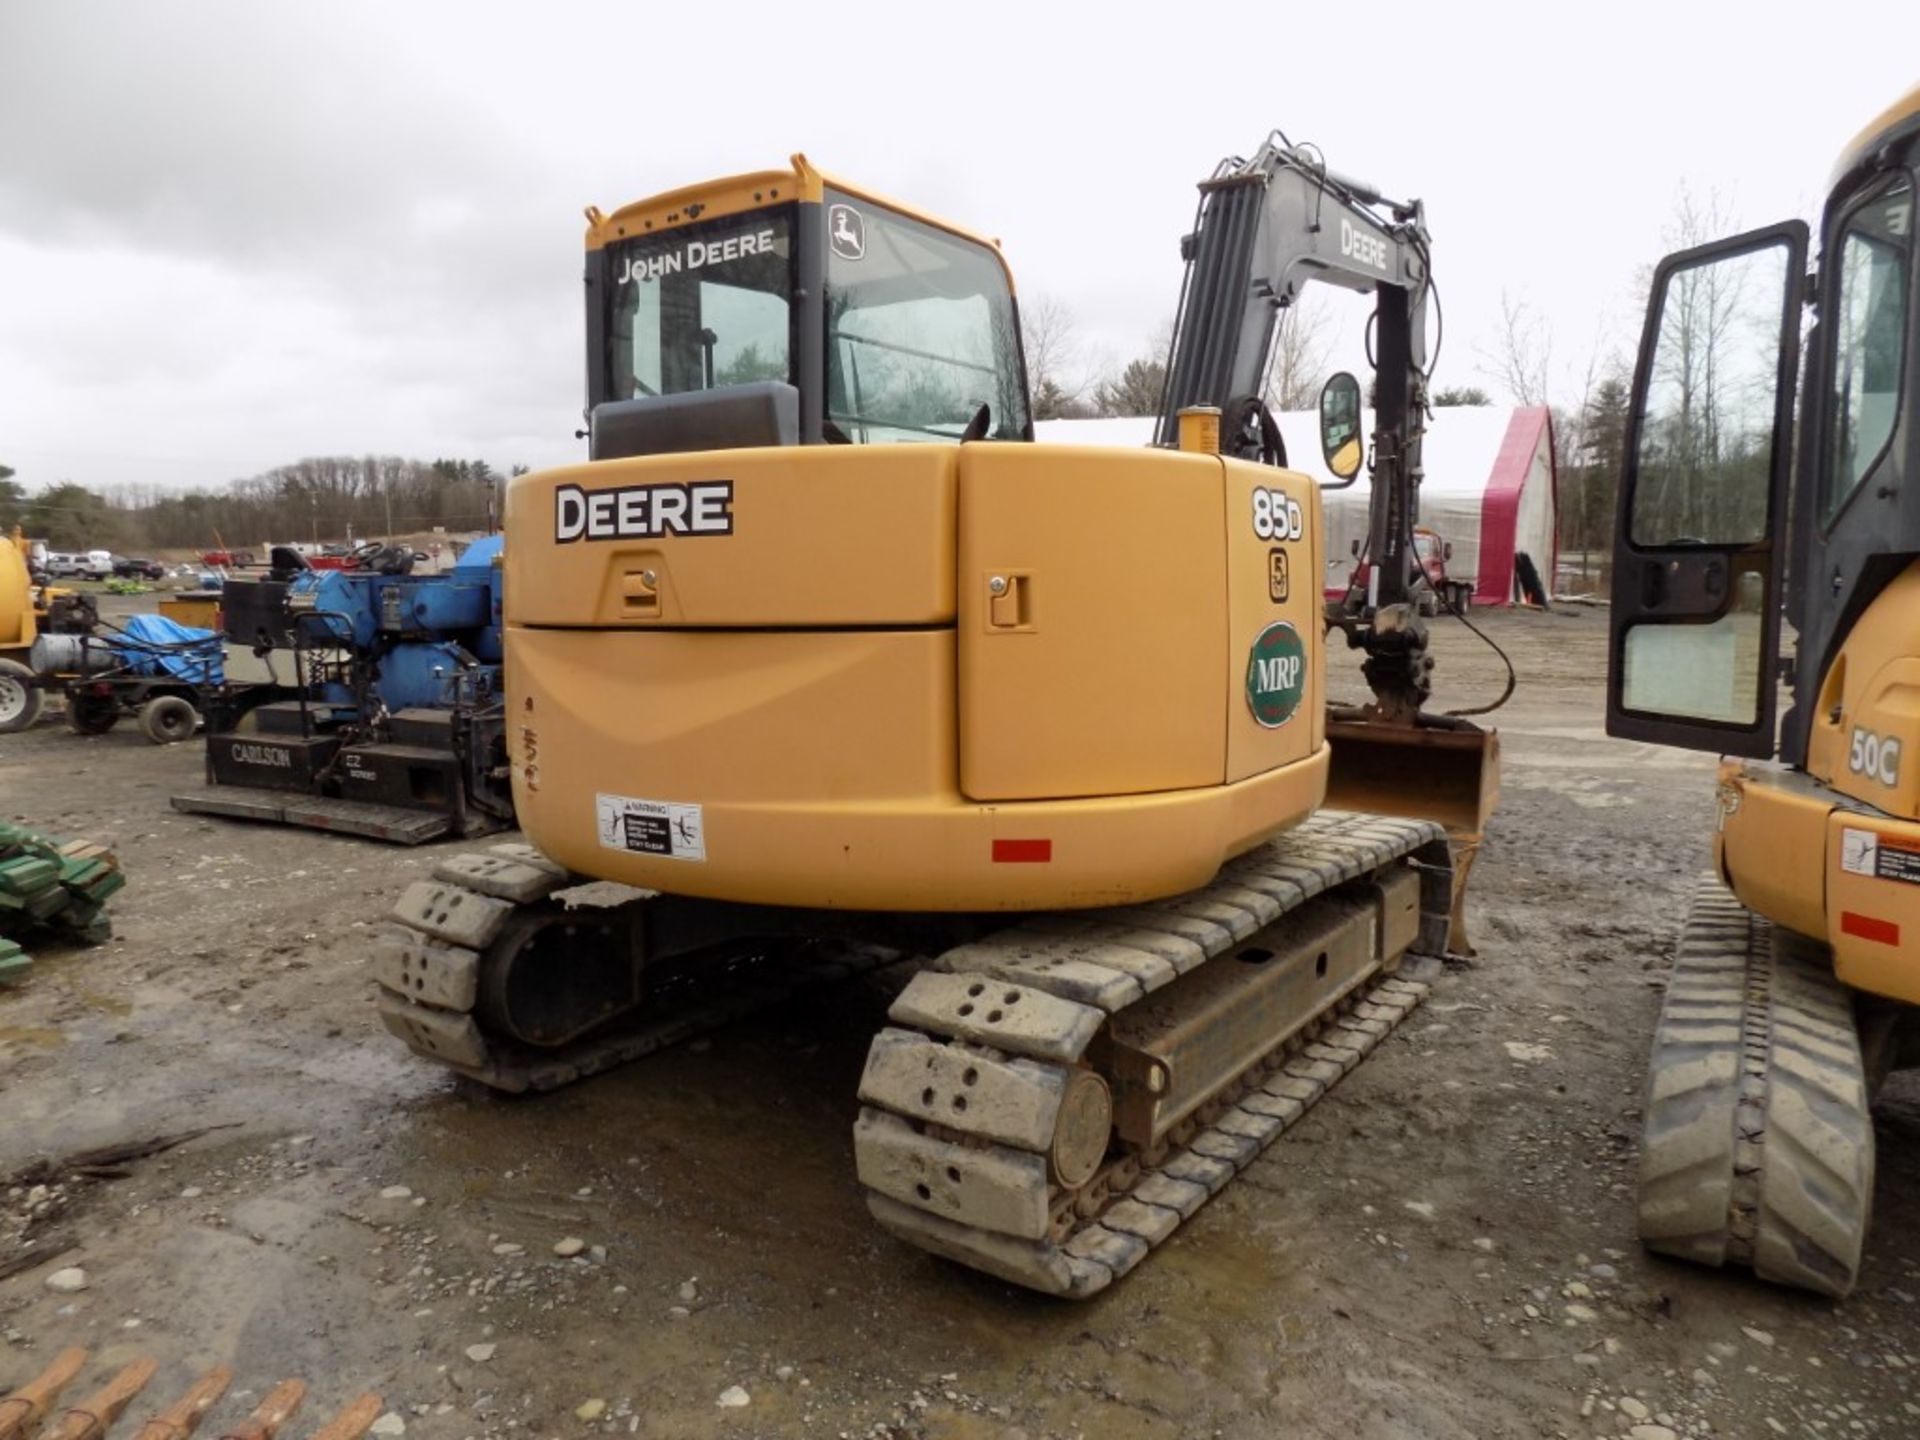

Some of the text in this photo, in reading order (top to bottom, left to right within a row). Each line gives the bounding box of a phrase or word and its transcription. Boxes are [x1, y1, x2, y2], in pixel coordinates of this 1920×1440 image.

[618, 229, 774, 285] JOHN DEERE
[1341, 218, 1387, 271] DEERE
[556, 482, 732, 543] DEERE
[1253, 487, 1302, 541] 85D
[1256, 655, 1300, 694] MRP
[232, 743, 291, 767] CARLSON
[1850, 728, 1900, 786] 50C
